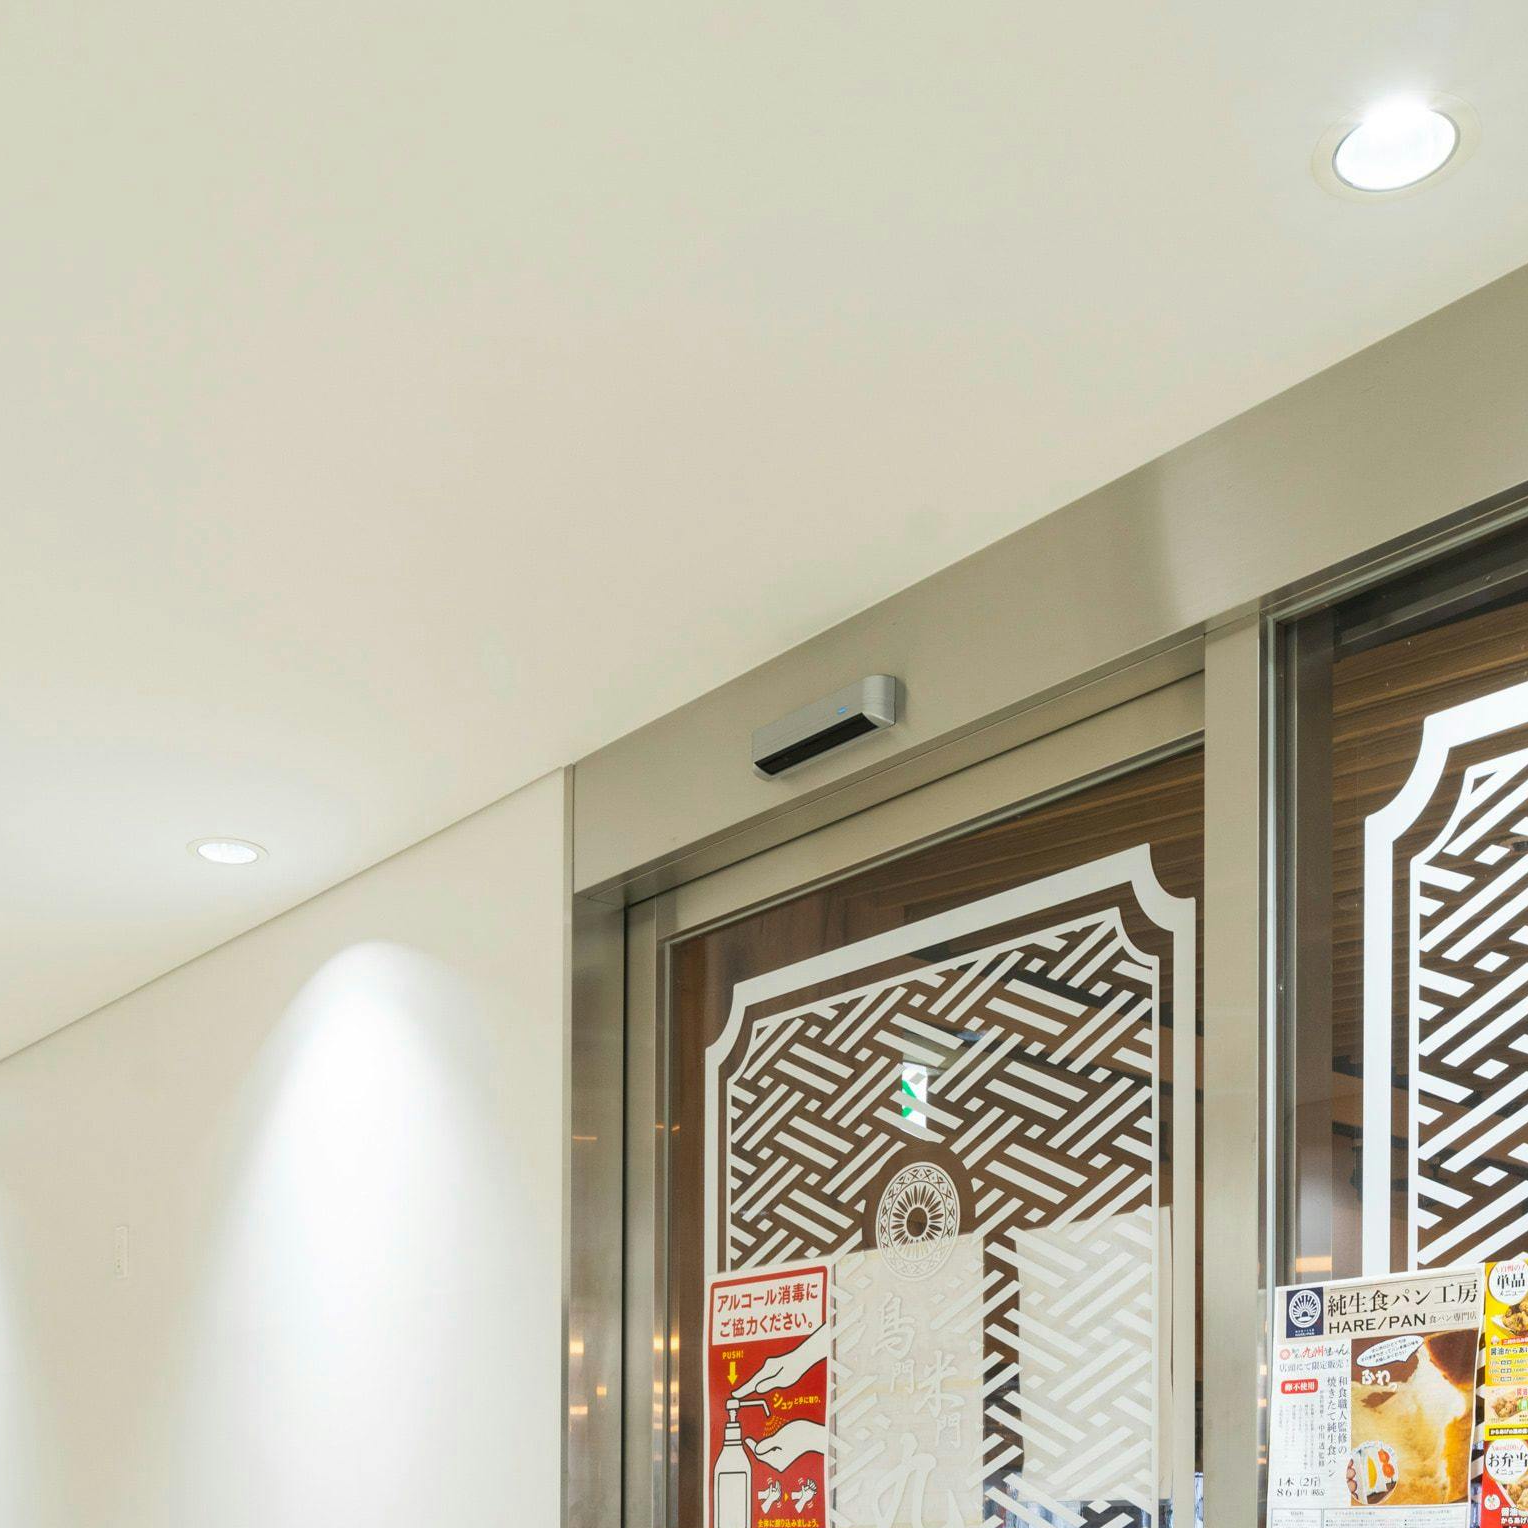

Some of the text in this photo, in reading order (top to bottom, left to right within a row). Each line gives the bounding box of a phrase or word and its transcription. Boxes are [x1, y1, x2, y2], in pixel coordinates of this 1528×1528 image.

[1497, 1272, 1525, 1289] 単品
[717, 1283, 819, 1313] アルコール消毒に
[1328, 1280, 1479, 1317] 純生食パン工房
[719, 1312, 813, 1338] ご協力ください。
[1329, 1313, 1426, 1334] HARE/PAN
[722, 1350, 744, 1360] PUSH!
[1327, 1376, 1337, 1478] 焼きたて純生食パン
[1338, 1376, 1347, 1454] 和食職人監修の
[1488, 1452, 1528, 1467] お弁当
